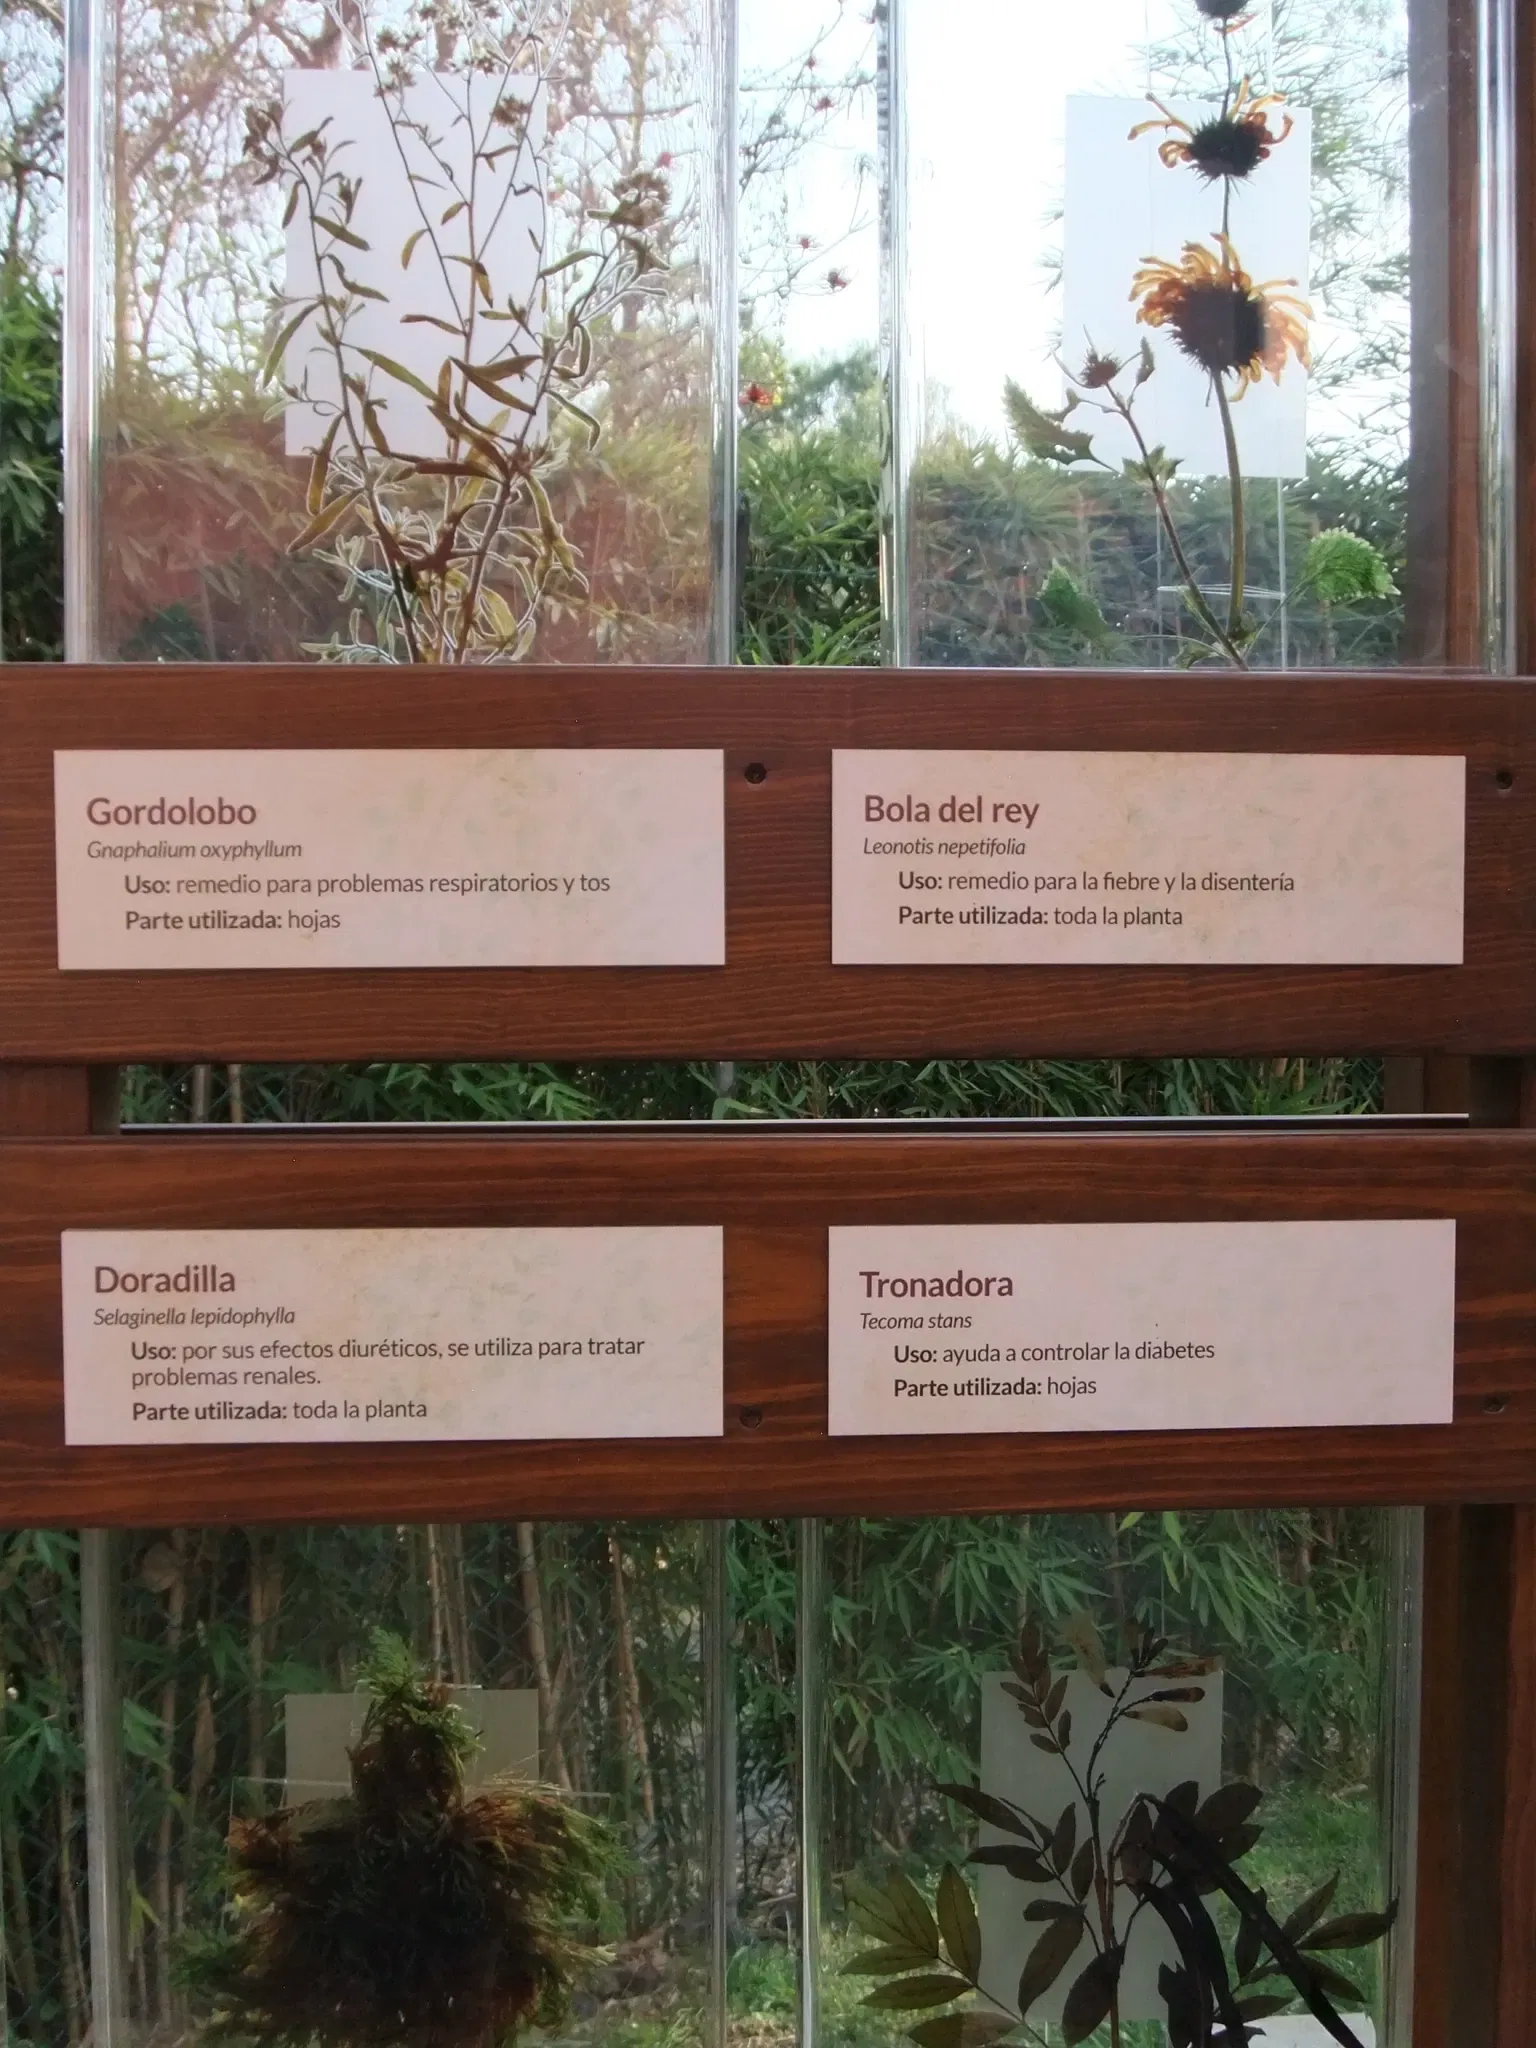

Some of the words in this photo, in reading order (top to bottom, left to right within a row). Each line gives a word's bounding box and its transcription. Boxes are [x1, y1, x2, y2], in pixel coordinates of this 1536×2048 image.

[86, 796, 257, 826] Gordolobo
[864, 794, 931, 823] Bola
[938, 794, 983, 824] del
[992, 802, 1040, 830] rey
[86, 840, 196, 863] Gnaphalium
[199, 839, 303, 862] oxyphyllum
[863, 837, 934, 855] Leonotis
[937, 837, 1026, 859] nepetifolia
[124, 874, 171, 895] Uso:
[176, 873, 262, 894] remedio
[266, 878, 312, 898] para
[317, 873, 425, 897] problemas
[429, 872, 559, 897] respiratorios
[562, 877, 576, 896] y
[579, 873, 611, 892] tos
[898, 870, 943, 890] Uso:
[948, 871, 1030, 890] remedio
[1034, 875, 1077, 894] para
[1082, 870, 1099, 891] la
[1103, 871, 1161, 891] fiebre
[1163, 876, 1176, 895] y
[1181, 871, 1197, 891] la
[1200, 871, 1295, 892] disentería
[125, 910, 185, 931] Parte
[188, 909, 283, 930] utilizada:
[288, 909, 342, 933] hojas
[898, 905, 955, 925] Parte
[958, 905, 1049, 925] utilizada:
[1053, 905, 1097, 925] toda
[1102, 905, 1118, 925] la
[1123, 906, 1183, 929] planta
[94, 1264, 236, 1294] Doradilla
[858, 1269, 1013, 1299] Tronadora
[93, 1307, 187, 1330] Selaginella
[190, 1306, 296, 1329] lepidophylla
[859, 1312, 924, 1330] Tecoma
[927, 1312, 973, 1329] stans
[131, 1341, 177, 1361] Uso:
[182, 1345, 218, 1364] por
[222, 1344, 255, 1360] sus
[259, 1339, 334, 1359] efectos
[338, 1338, 444, 1360] diuréticos,
[447, 1342, 470, 1358] se
[474, 1337, 533, 1357] utiliza
[538, 1341, 583, 1360] para
[587, 1337, 646, 1356] tratar
[894, 1344, 938, 1364] Uso:
[942, 1343, 1001, 1367] ayuda
[1005, 1347, 1017, 1362] a
[1021, 1341, 1110, 1362] controlar
[1114, 1341, 1131, 1361] la
[1134, 1340, 1215, 1360] diabetes
[131, 1366, 238, 1390] problemas
[243, 1365, 321, 1385] renales.
[894, 1378, 949, 1398] Parte
[953, 1376, 1042, 1397] utilizada:
[1047, 1375, 1097, 1399] hojas
[132, 1402, 190, 1422] Parte
[194, 1400, 288, 1421] utilizada:
[292, 1399, 338, 1420] toda
[343, 1399, 360, 1419] la
[365, 1399, 428, 1423] planta
